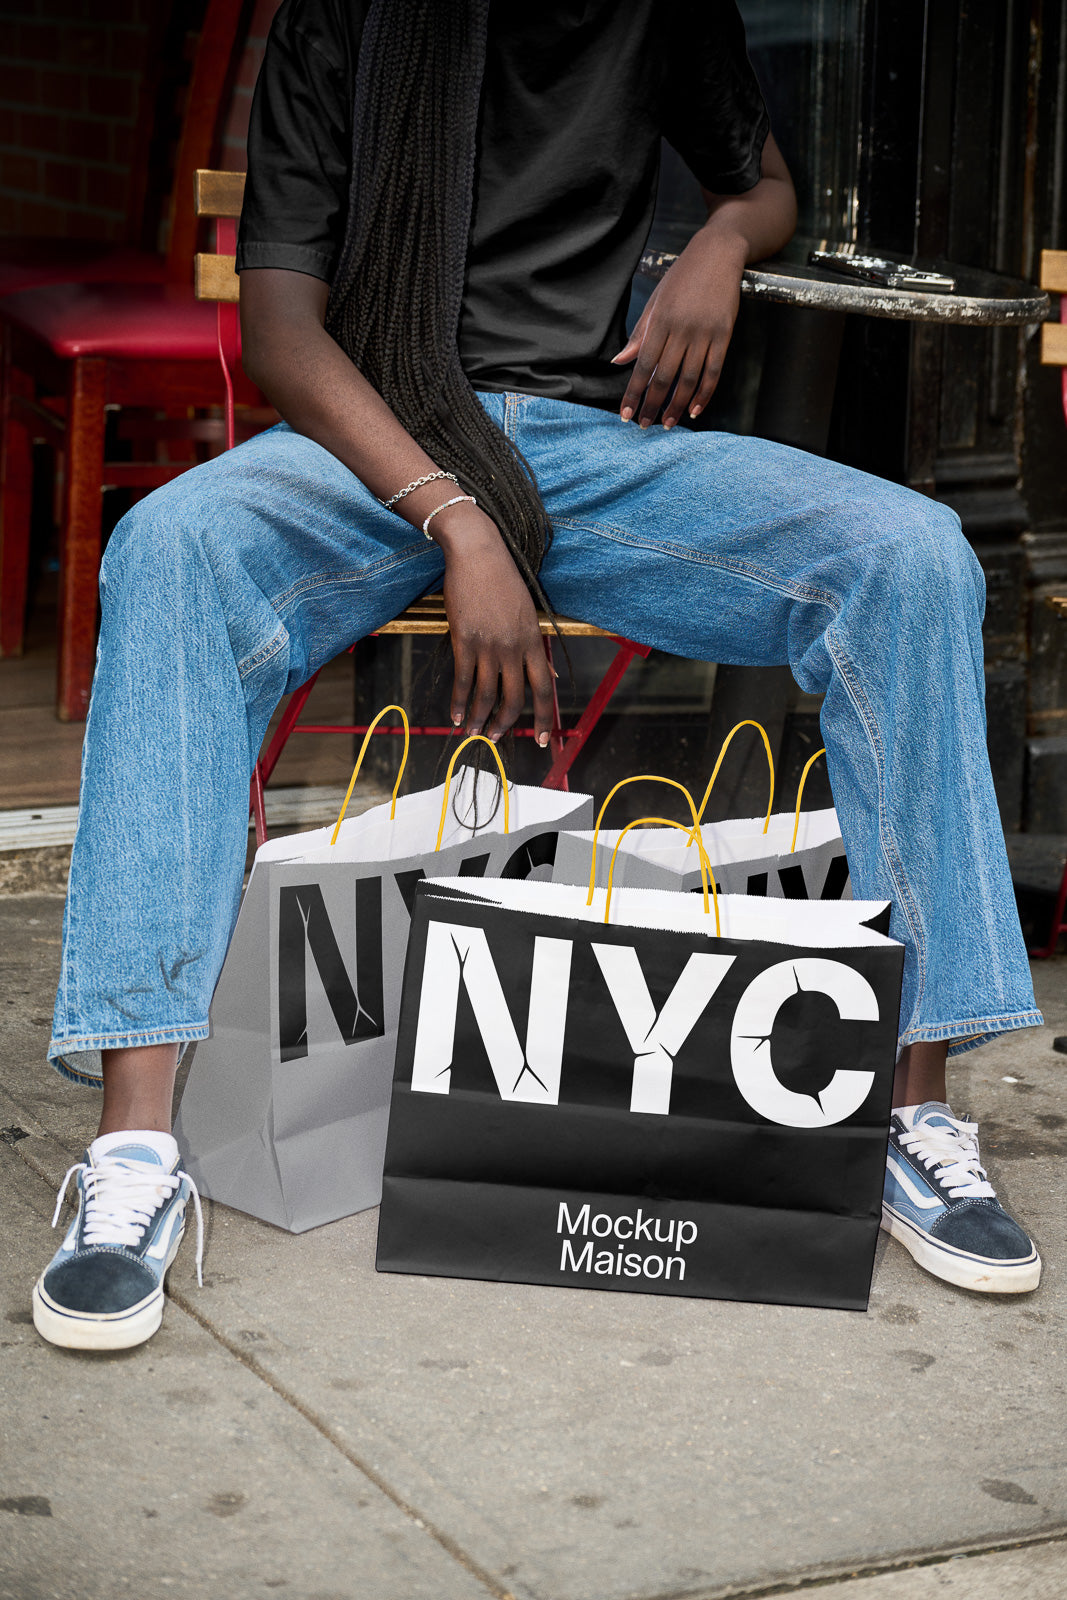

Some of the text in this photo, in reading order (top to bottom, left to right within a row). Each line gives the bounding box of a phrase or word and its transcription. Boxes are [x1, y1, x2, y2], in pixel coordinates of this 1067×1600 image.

[411, 920, 880, 1128] NYC
[557, 1202, 698, 1251] Mockup
[560, 1239, 686, 1280] Maison
